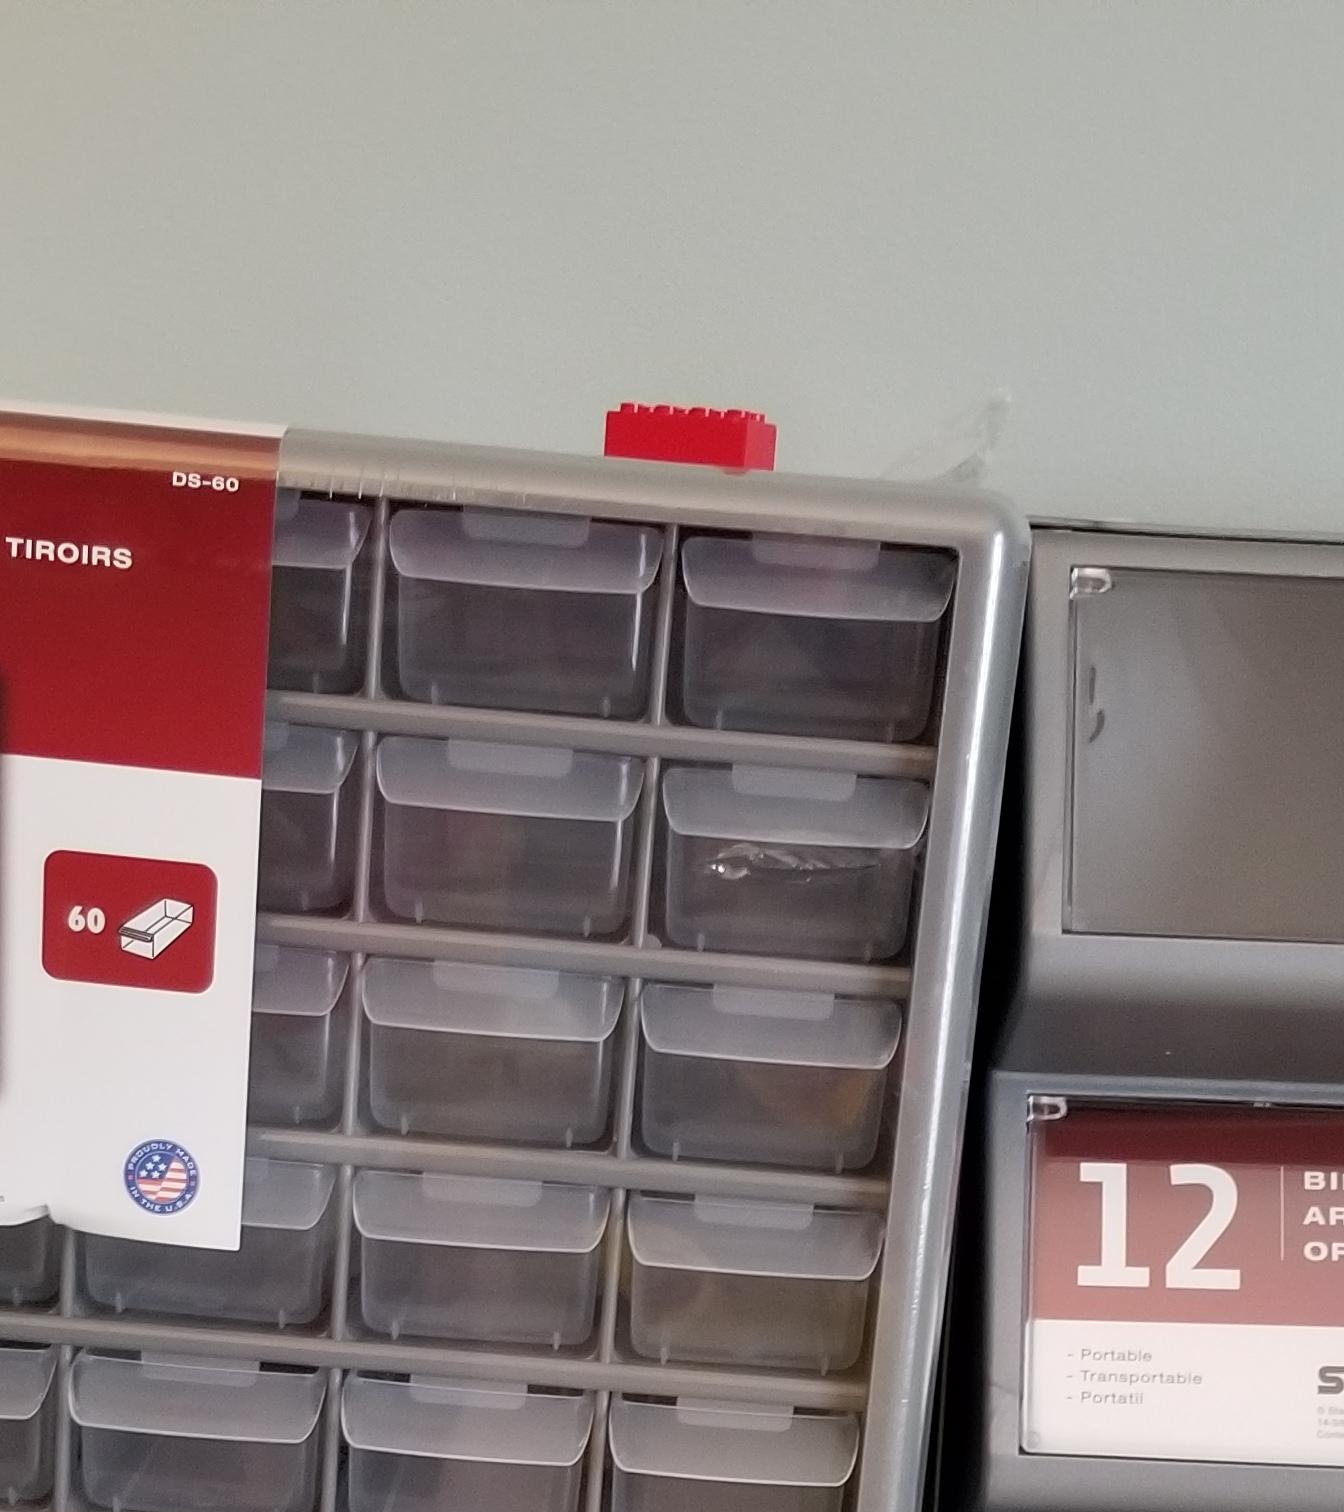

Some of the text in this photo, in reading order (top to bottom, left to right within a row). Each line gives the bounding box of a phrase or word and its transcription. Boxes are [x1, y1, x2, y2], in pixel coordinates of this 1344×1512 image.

[172, 471, 239, 492] DS-60
[5, 537, 132, 569] TIROIRS
[67, 905, 106, 935] 60
[127, 1142, 197, 1176] PROUDLY MADE
[129, 1186, 140, 1198] IN
[140, 1198, 161, 1212] THE
[1076, 1161, 1242, 1291] 12
[1081, 1348, 1153, 1362] Portable
[1079, 1369, 1203, 1385] Transportable
[1080, 1391, 1144, 1405] Portatil
